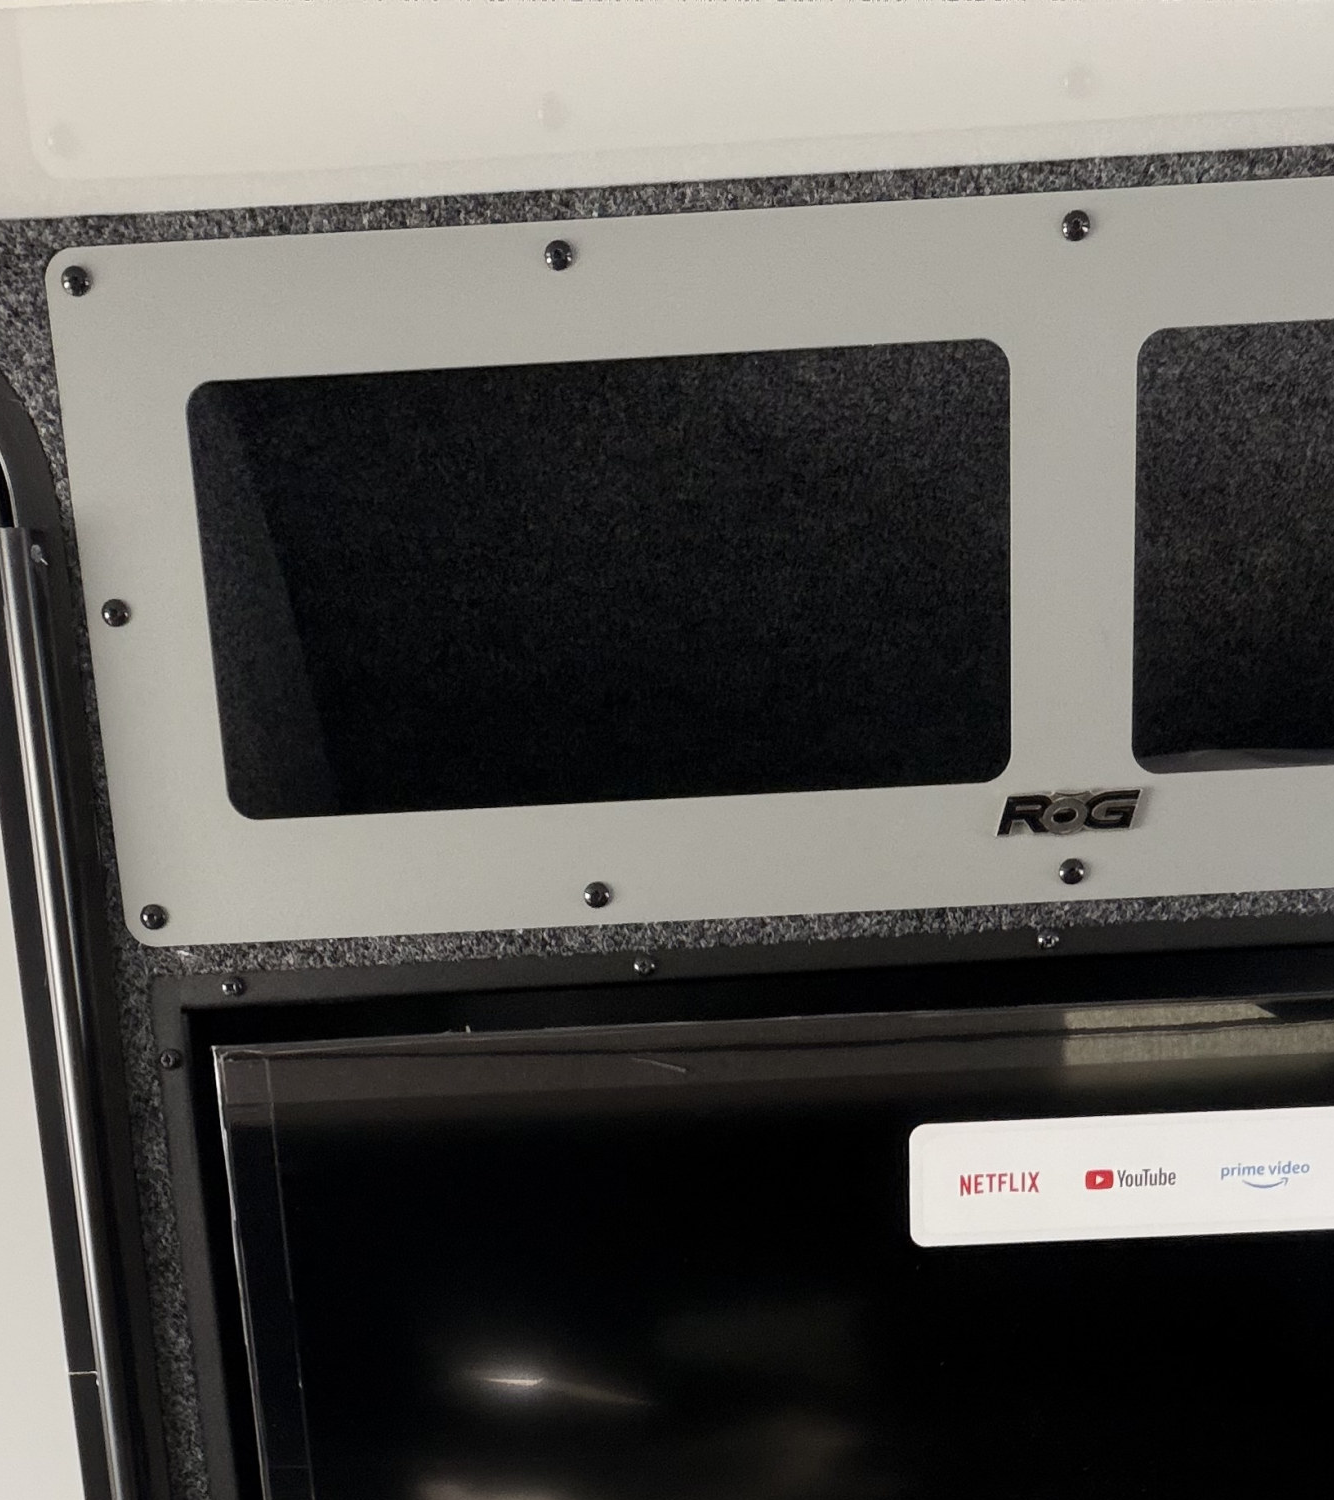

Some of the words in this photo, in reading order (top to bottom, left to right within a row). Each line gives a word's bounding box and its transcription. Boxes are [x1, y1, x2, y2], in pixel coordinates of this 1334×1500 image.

[995, 788, 1144, 837] ROG
[1117, 1167, 1177, 1188] YouTube
[1220, 1163, 1265, 1180] prime
[1268, 1160, 1310, 1175] video
[959, 1171, 1040, 1197] NETFLIX
